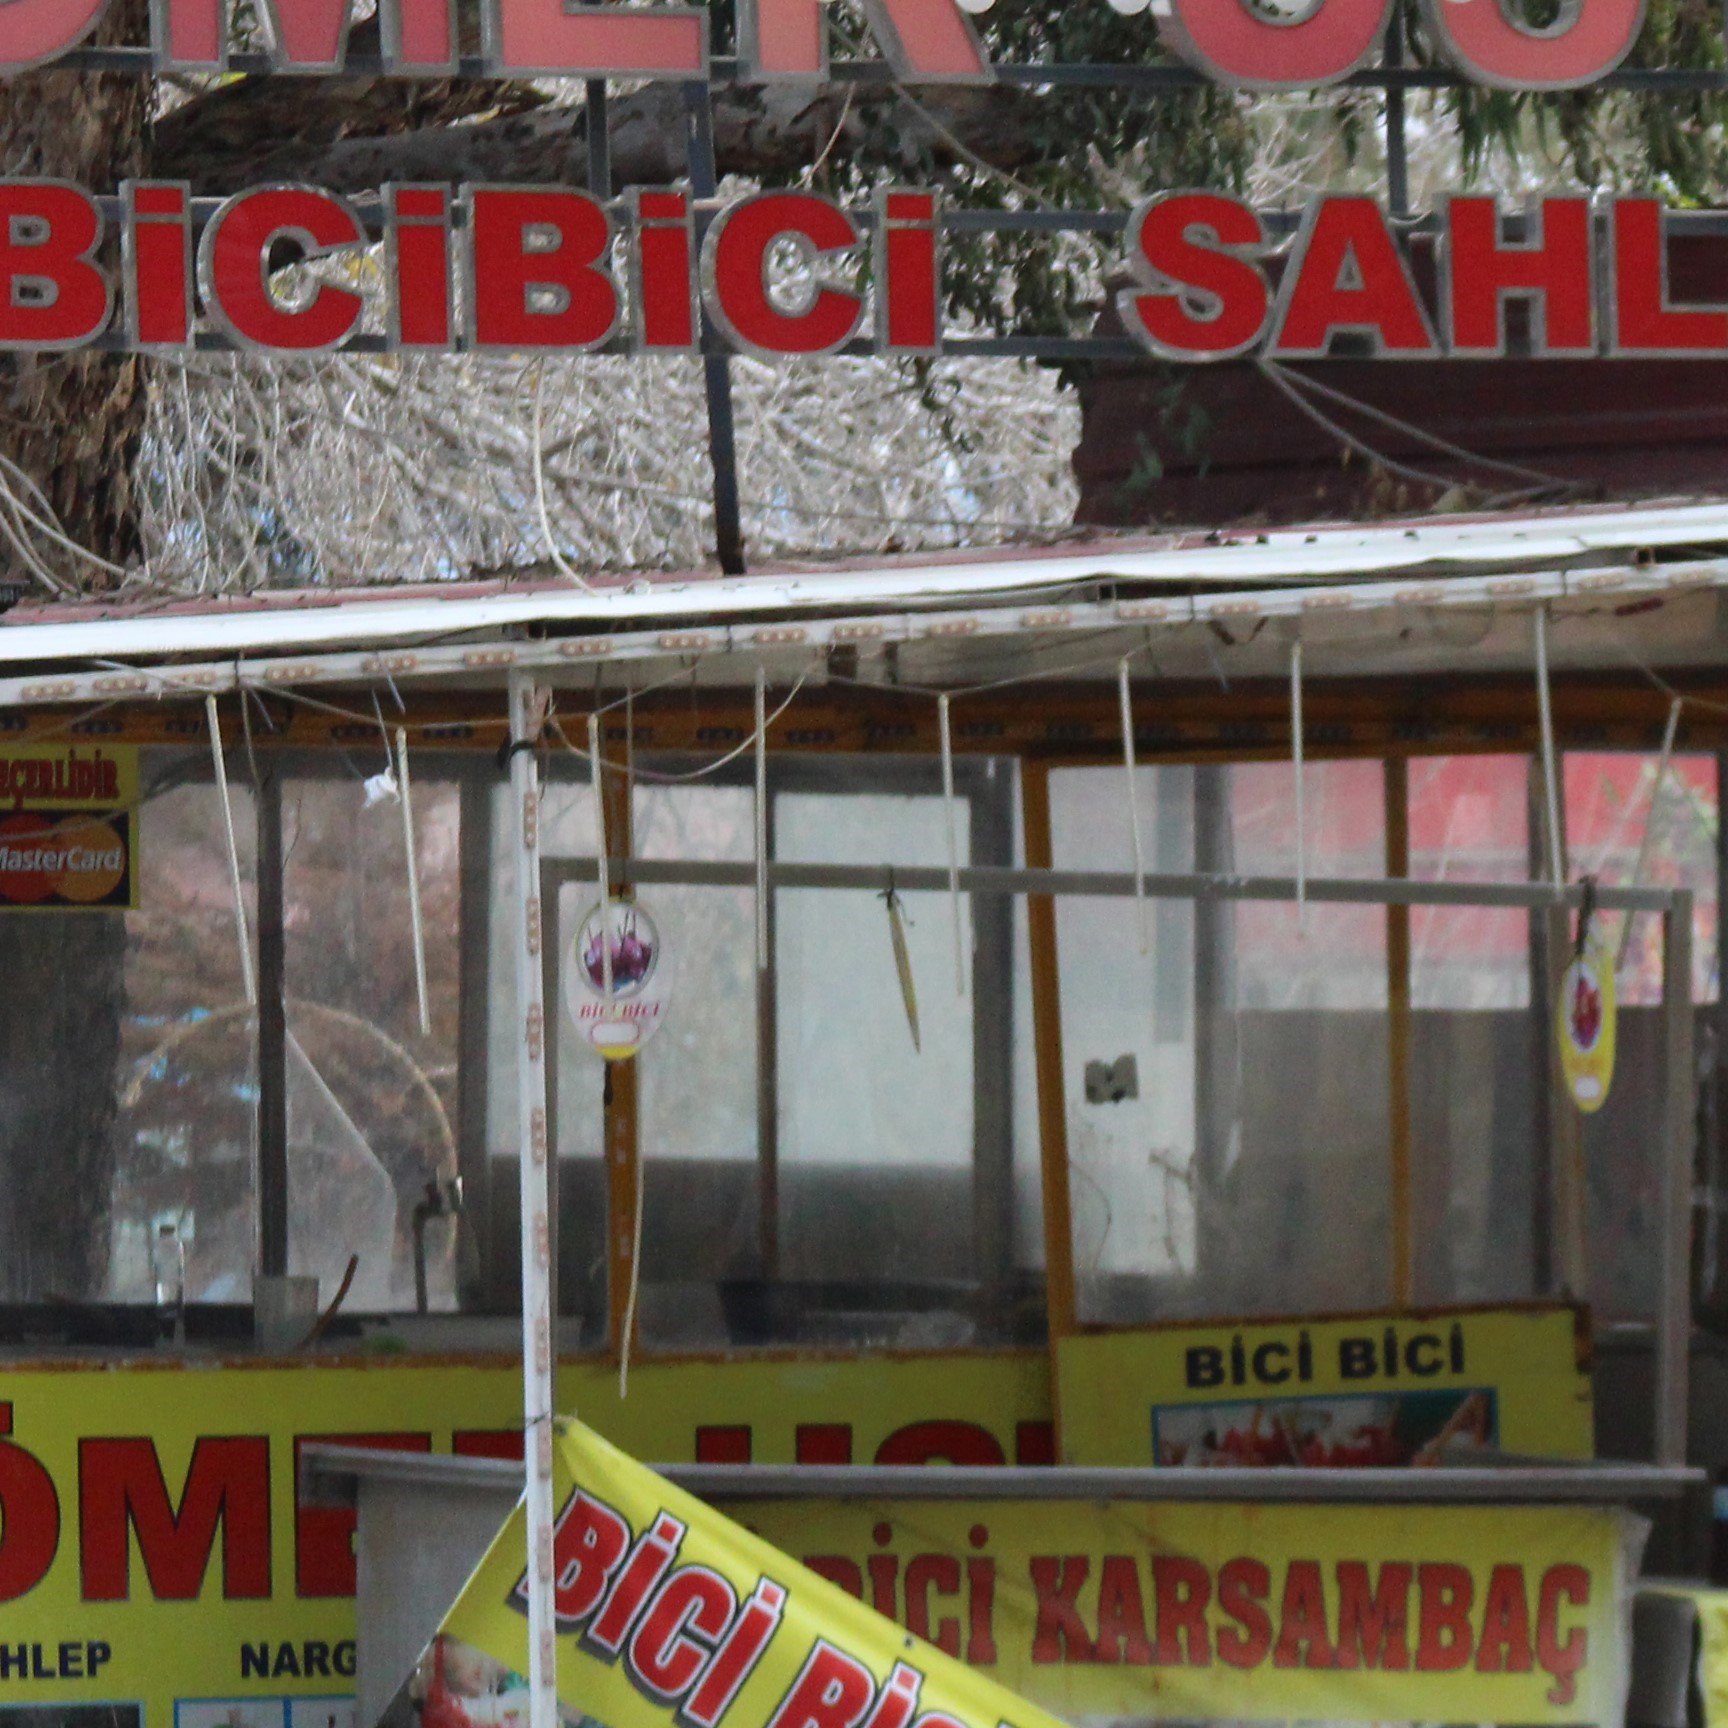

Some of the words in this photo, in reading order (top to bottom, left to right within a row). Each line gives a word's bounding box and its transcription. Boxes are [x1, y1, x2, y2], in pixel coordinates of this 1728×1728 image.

[1185, 1329, 1313, 1389] BİCİ
[1338, 1321, 1465, 1380] BİCİ
[1029, 1554, 1593, 1706] KARSAMBAÇ
